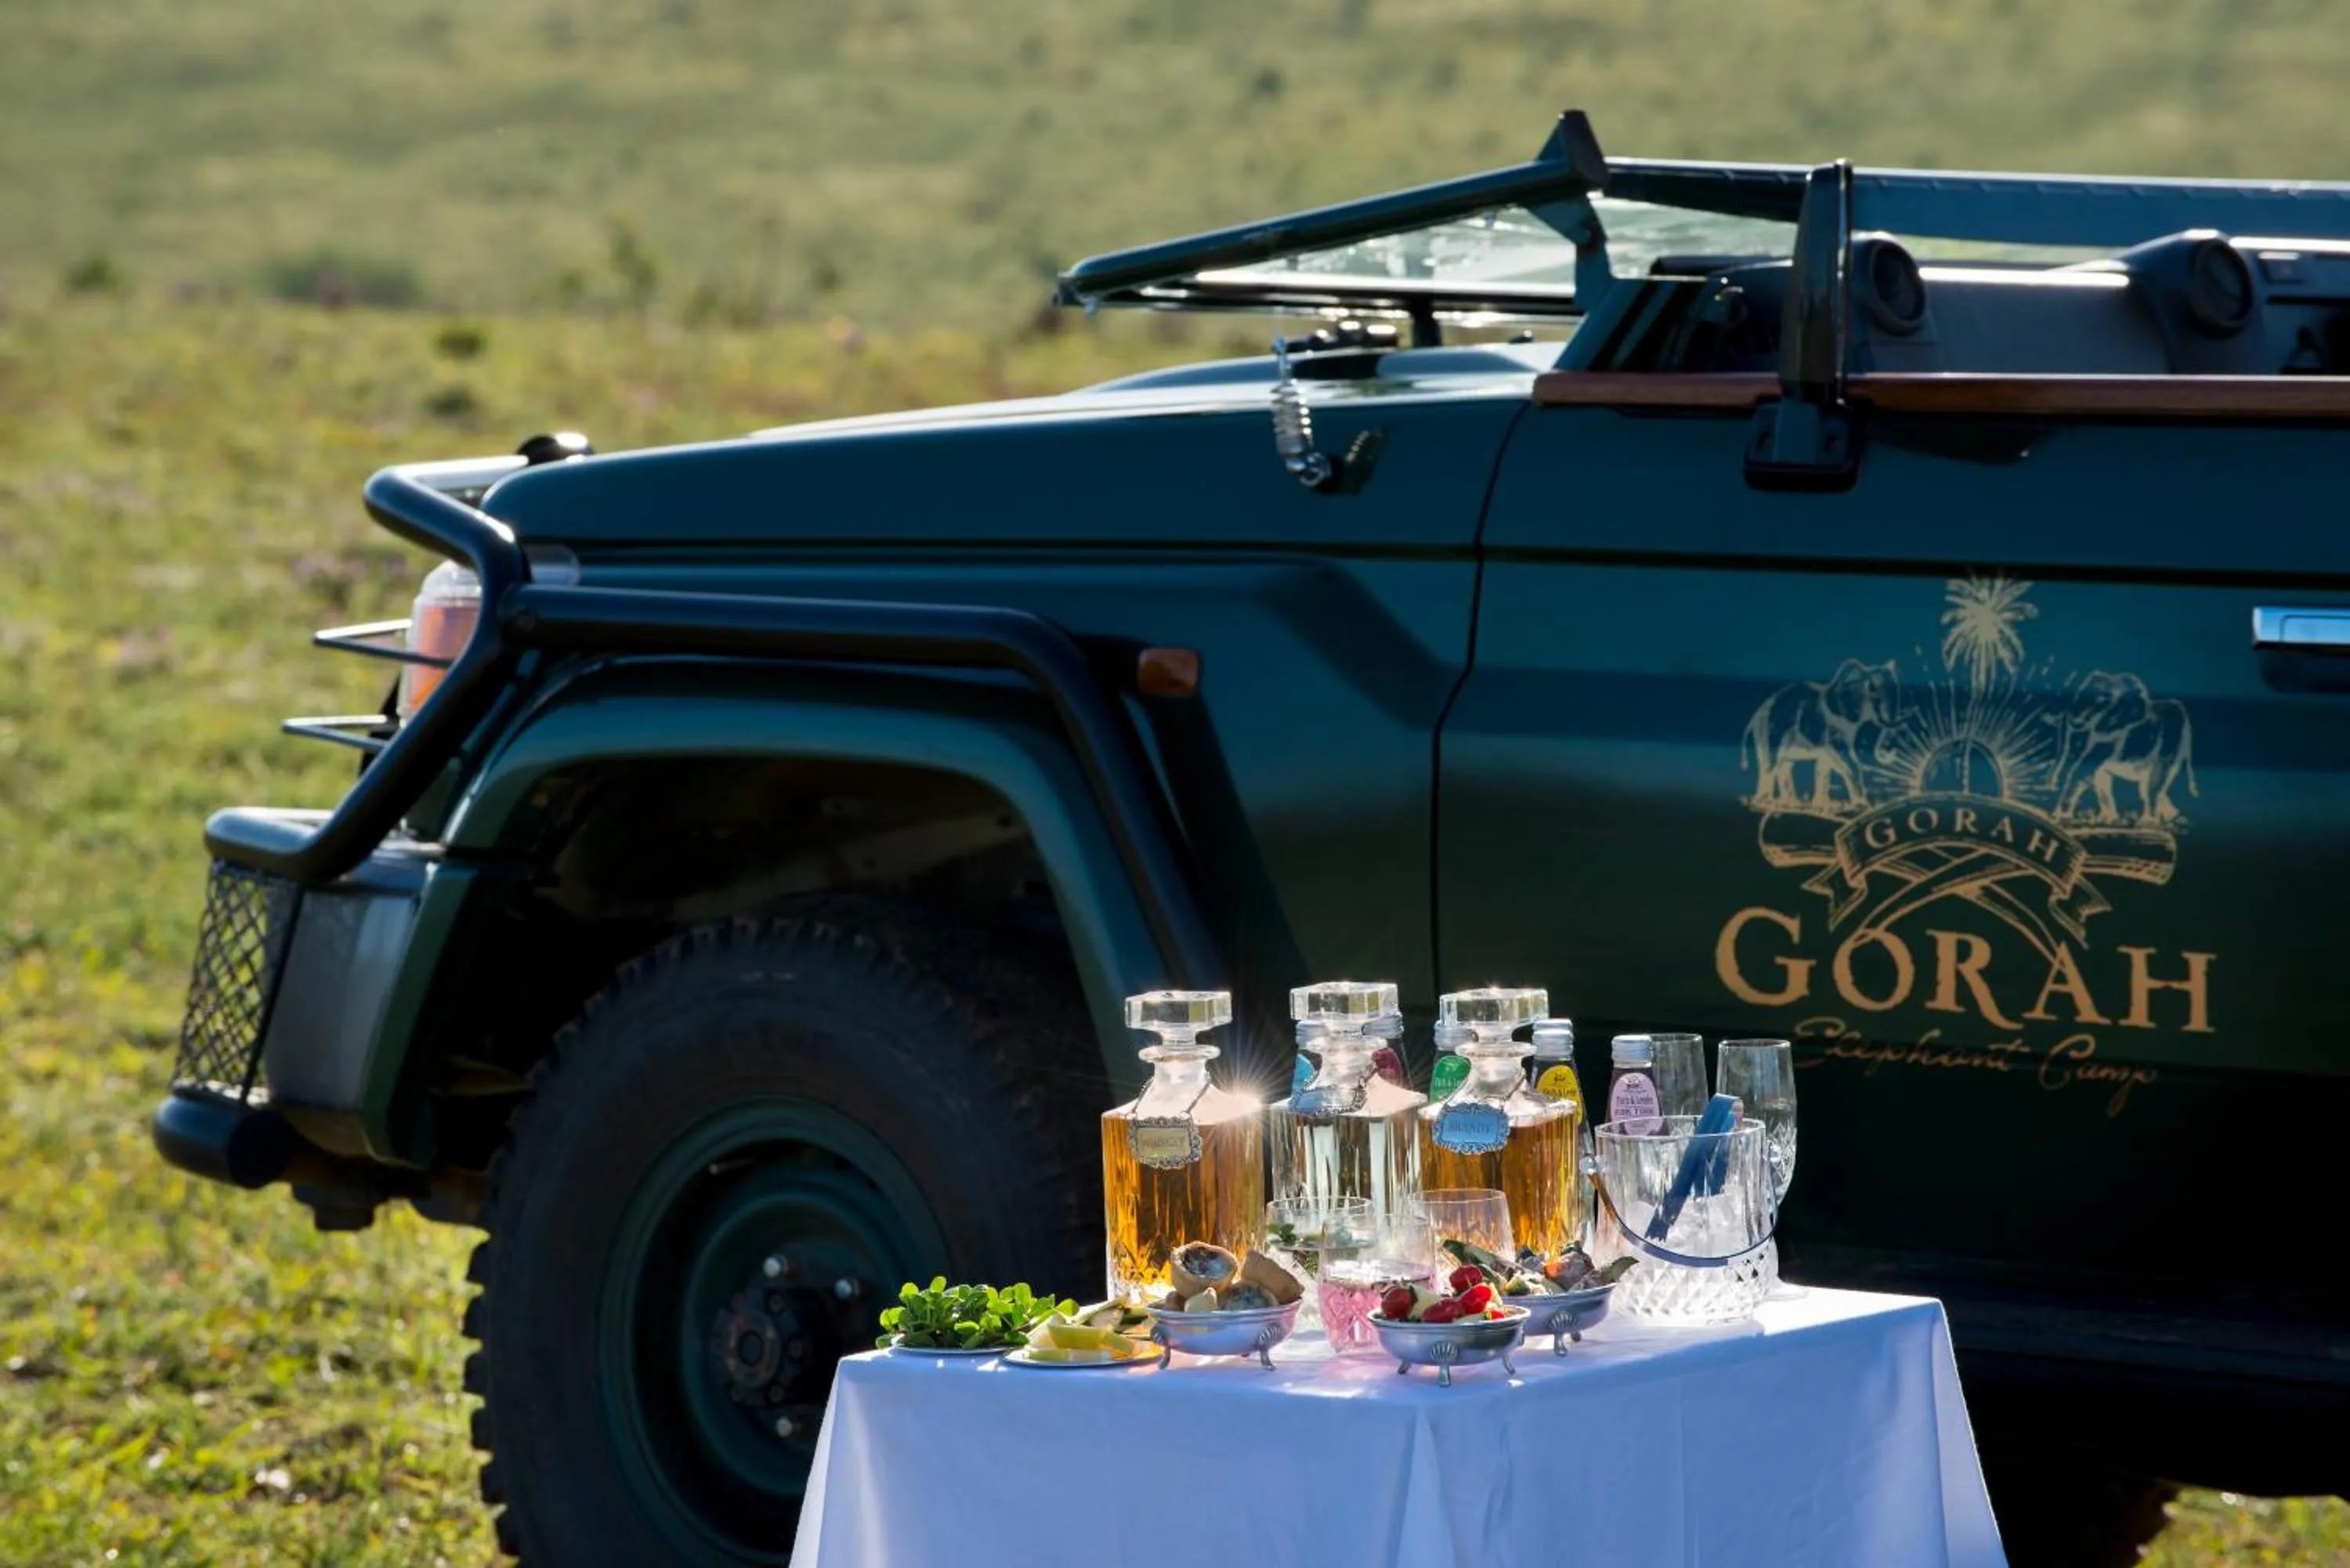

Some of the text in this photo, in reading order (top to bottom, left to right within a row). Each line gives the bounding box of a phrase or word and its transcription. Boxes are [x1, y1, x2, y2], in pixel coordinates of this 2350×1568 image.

[1865, 807, 2061, 862] GORAH
[1716, 906, 2218, 1033] GORAH
[1793, 1016, 2158, 1118] Elephant Camp
